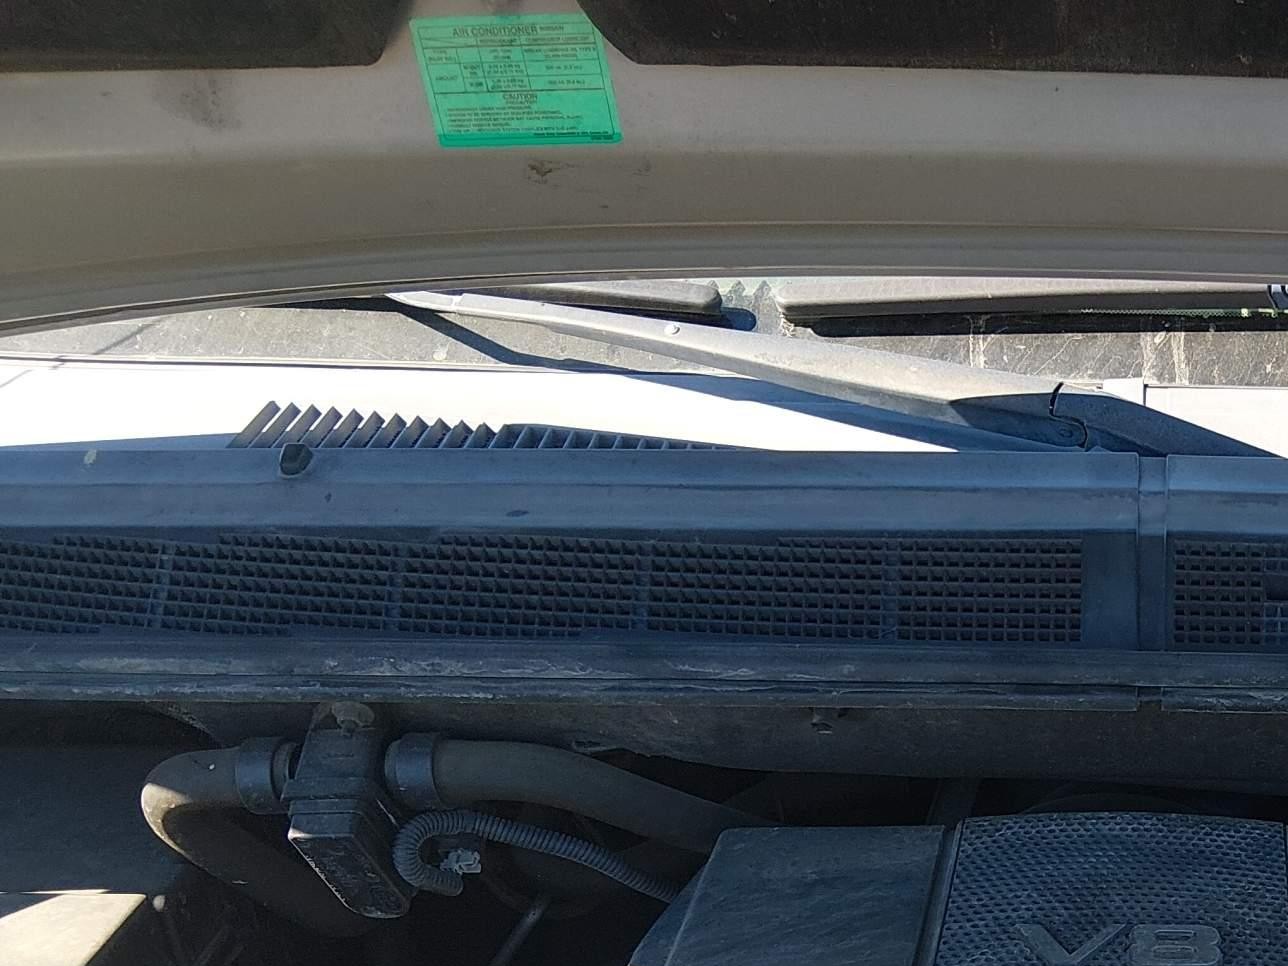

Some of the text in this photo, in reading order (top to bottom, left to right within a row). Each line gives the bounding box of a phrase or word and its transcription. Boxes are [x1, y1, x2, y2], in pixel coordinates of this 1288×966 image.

[453, 27, 470, 37] AIR
[471, 25, 538, 36] CONDITIONER
[503, 93, 537, 101] CAUTION
[1014, 923, 1222, 966] V8
